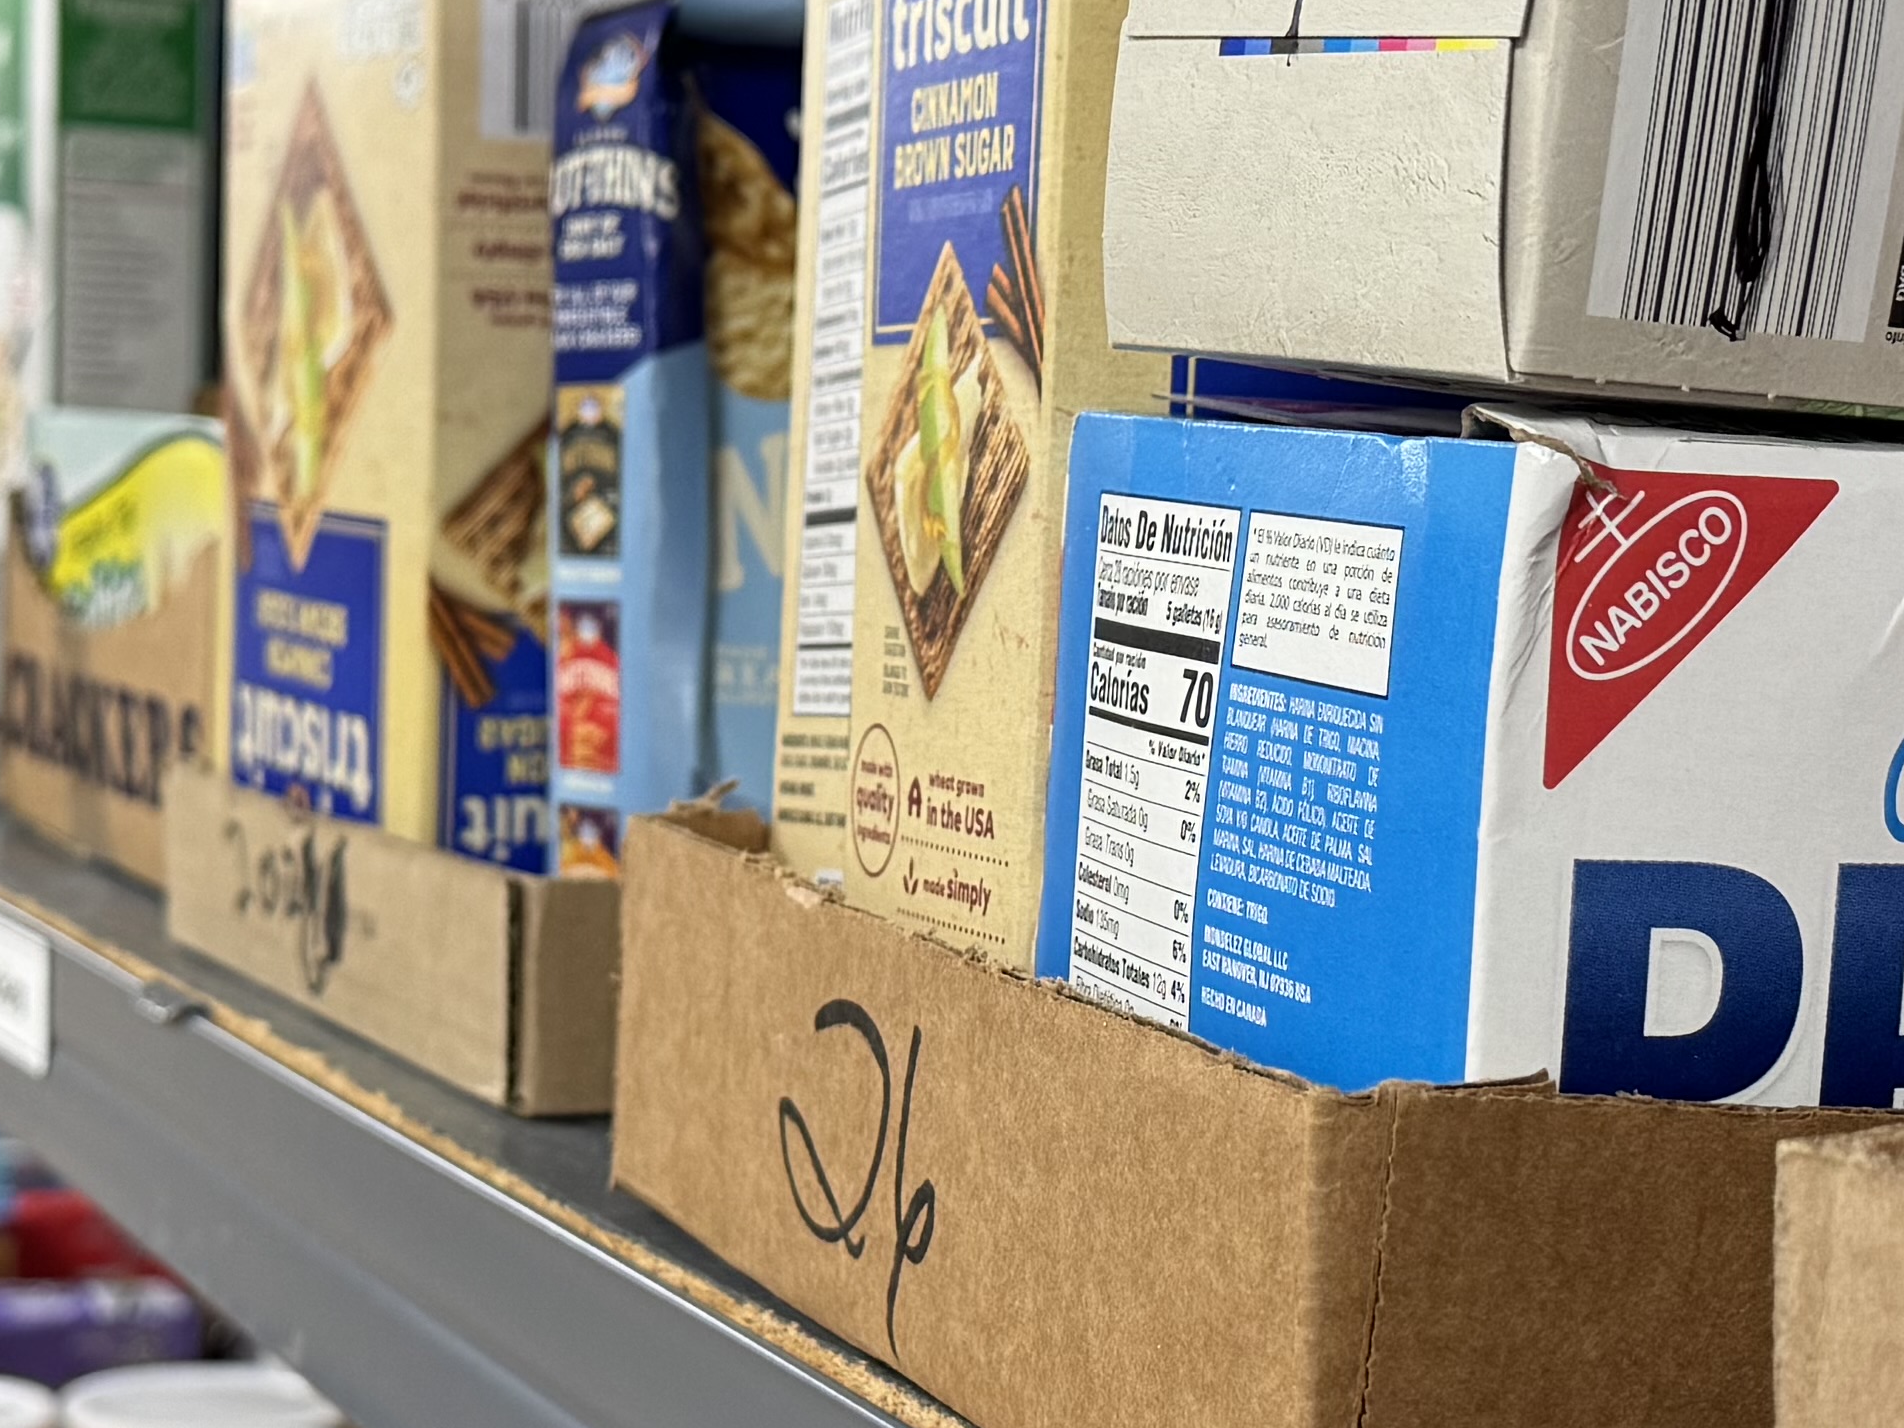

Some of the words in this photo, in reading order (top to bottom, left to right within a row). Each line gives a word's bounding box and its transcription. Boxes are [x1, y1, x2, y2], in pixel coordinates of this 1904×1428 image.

[911, 71, 999, 135] CINNAMON
[892, 134, 951, 189] BROWN
[953, 123, 1016, 178] SUGAR
[1100, 504, 1131, 550] Datos
[1135, 510, 1157, 553] De
[1162, 513, 1234, 564] Nutrición
[1578, 504, 1734, 668] NABISCO
[1090, 661, 1150, 716] Calorías
[1180, 669, 1214, 729] 70
[856, 782, 895, 823] quality
[929, 770, 955, 792] wheat
[956, 777, 985, 798] grown
[1185, 779, 1201, 804] 2%
[926, 796, 938, 827] in
[940, 800, 962, 833] the
[964, 804, 995, 840] USA
[923, 876, 945, 897] made
[946, 868, 992, 917] simply
[1169, 979, 1186, 1005] 4%
